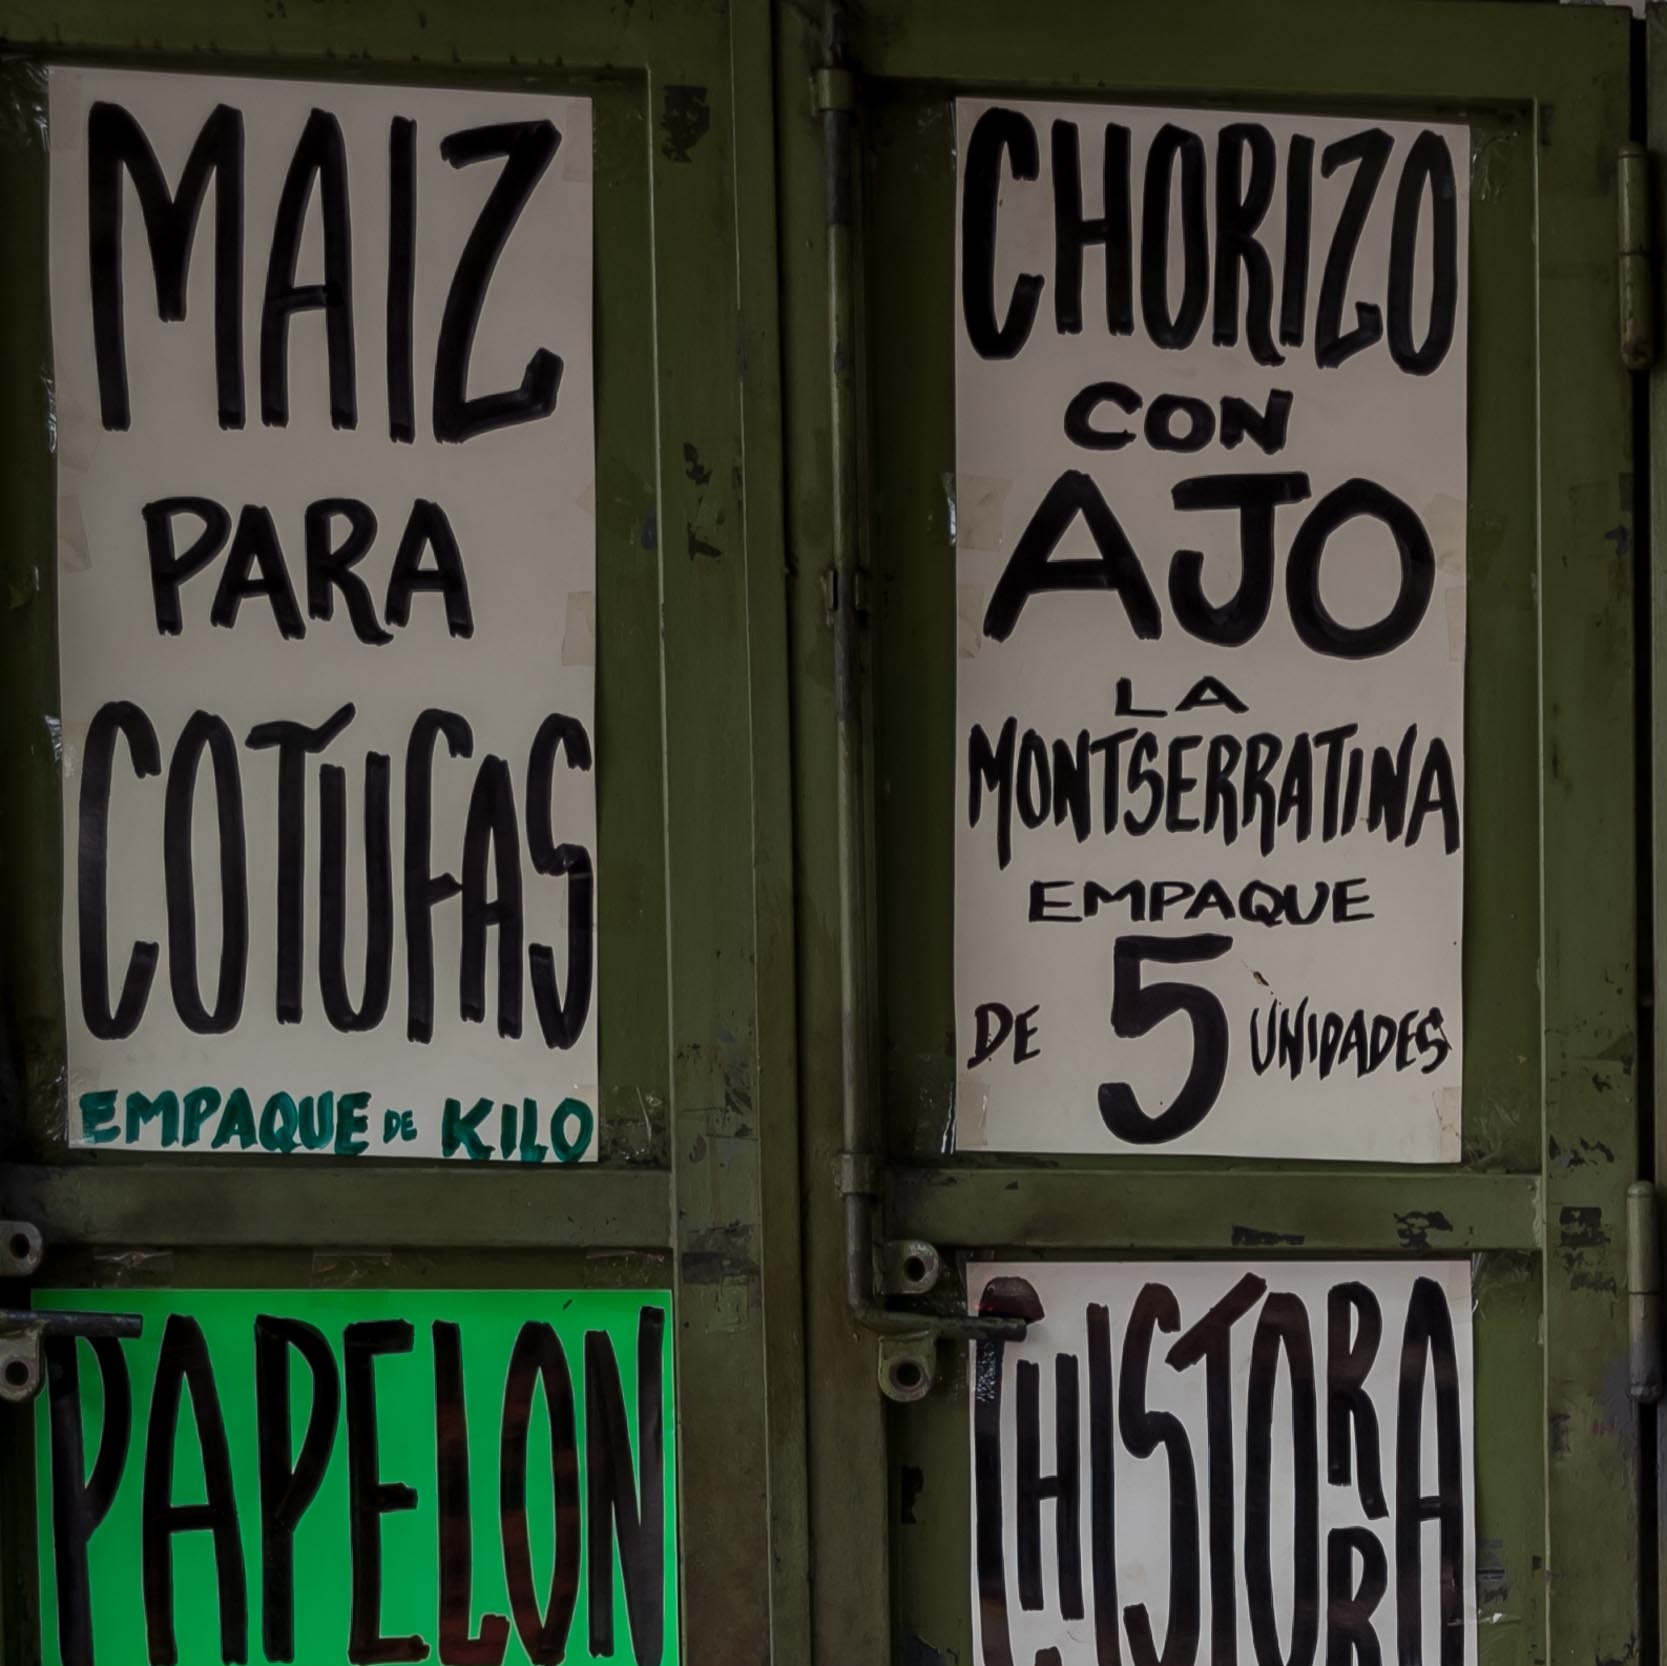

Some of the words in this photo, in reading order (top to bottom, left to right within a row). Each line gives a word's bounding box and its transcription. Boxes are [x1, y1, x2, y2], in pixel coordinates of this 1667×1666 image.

[87, 100, 564, 444] MAIZ
[961, 106, 1458, 376] CHORIZO
[1063, 381, 1294, 455] CON
[141, 496, 474, 646] PARA
[982, 469, 1436, 660] AJO
[1114, 675, 1249, 718] LA
[967, 716, 1460, 871] MONTSERRATINA
[77, 700, 594, 1050] COTUFAS
[1028, 877, 1375, 928] EMPAQUE
[966, 1002, 1041, 1070] DE
[1097, 932, 1234, 1145] 5
[1249, 996, 1452, 1081] UNIDADES
[80, 1085, 372, 1155] EMPAQUE
[382, 1109, 418, 1144] DE
[441, 1095, 594, 1163] KILO
